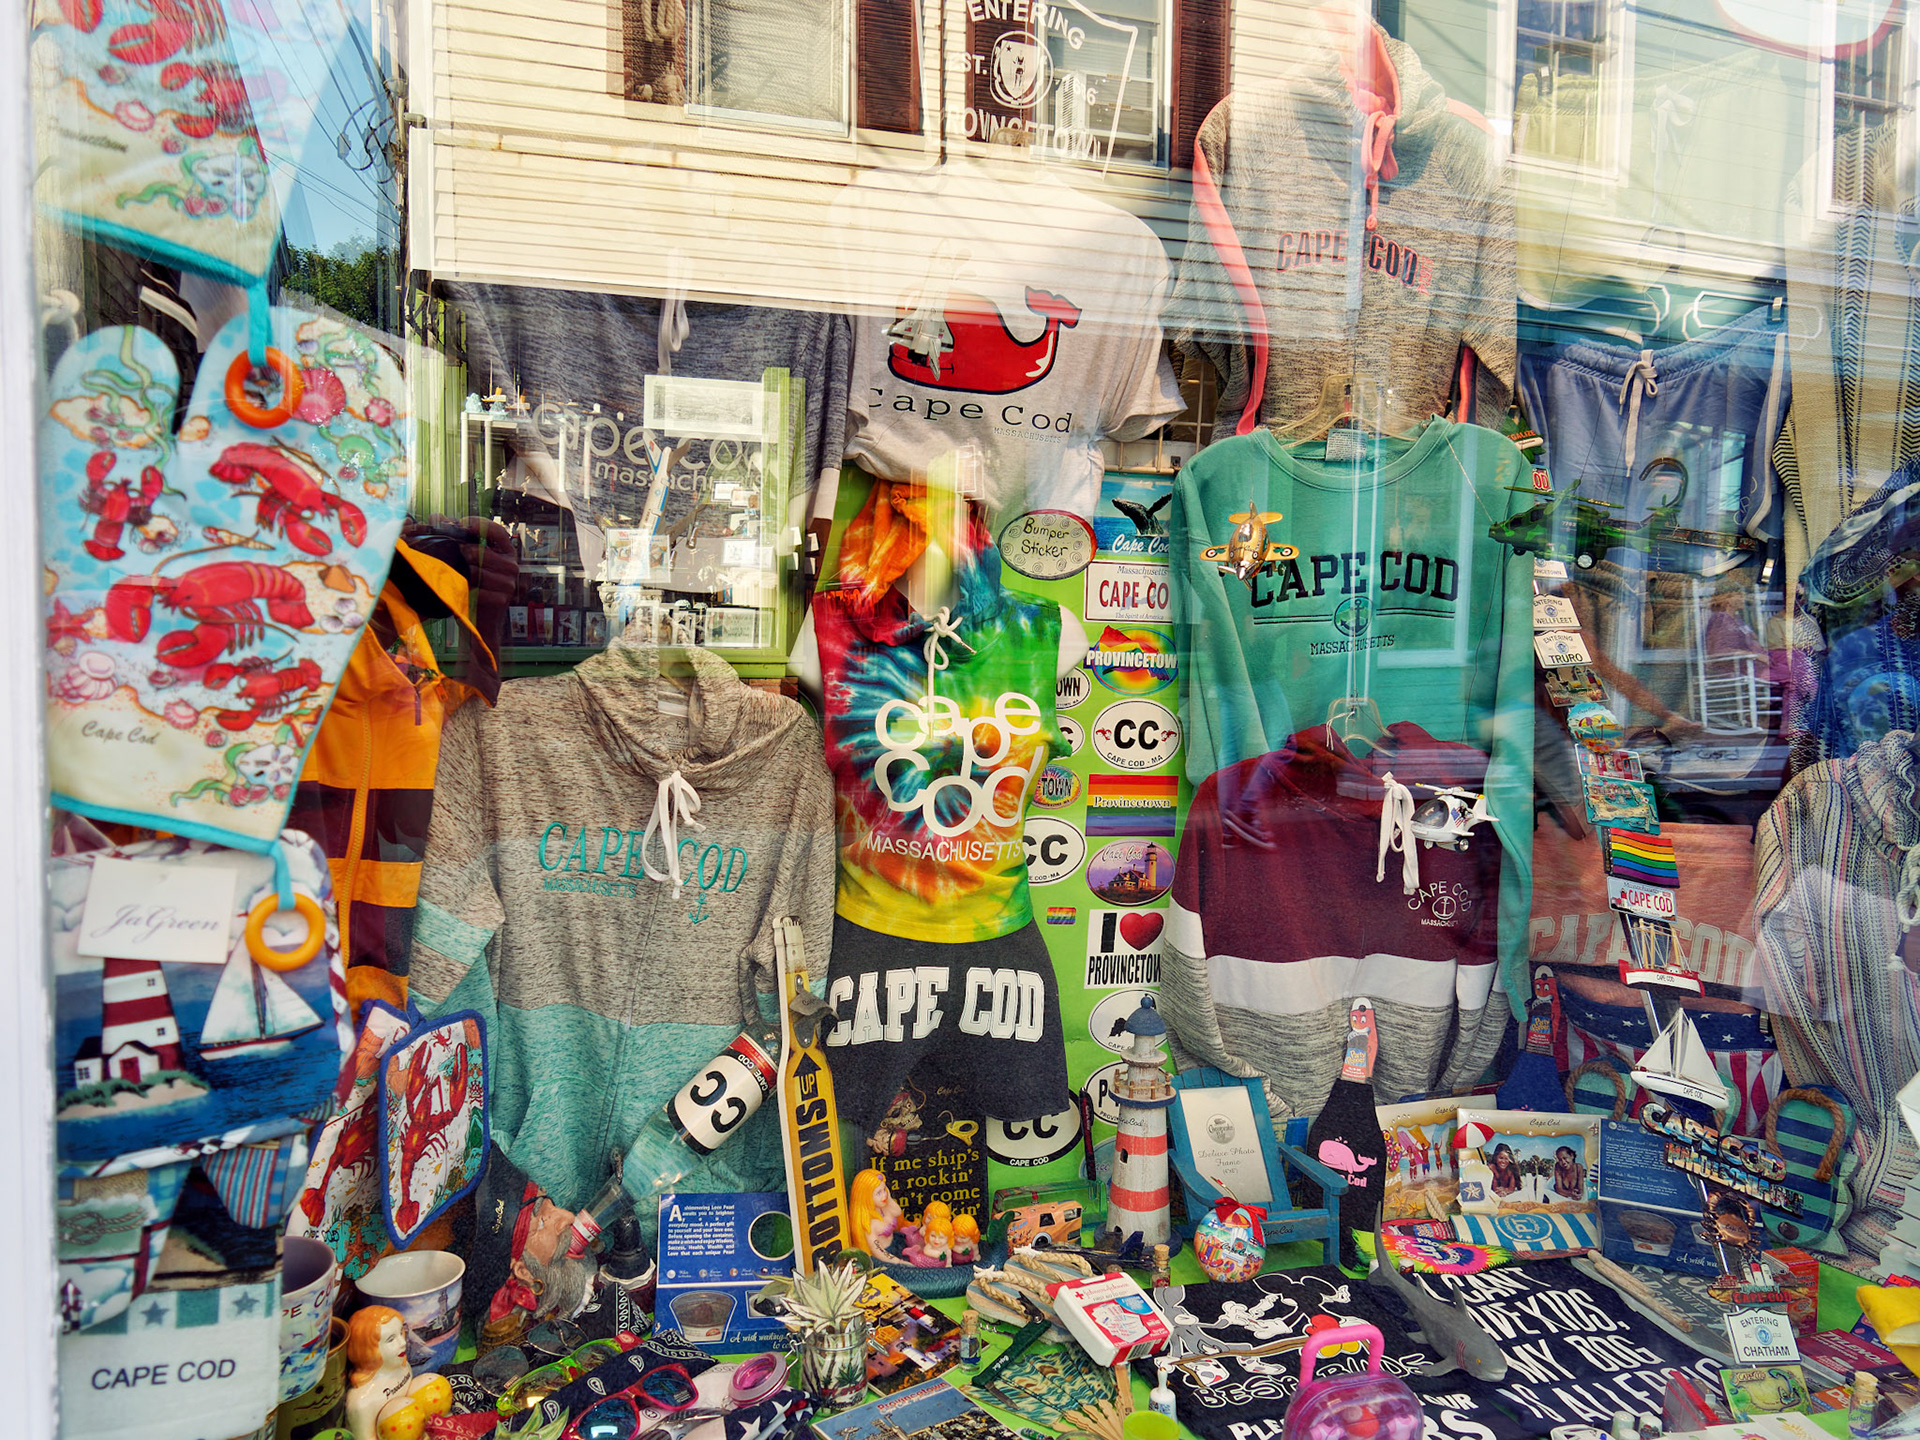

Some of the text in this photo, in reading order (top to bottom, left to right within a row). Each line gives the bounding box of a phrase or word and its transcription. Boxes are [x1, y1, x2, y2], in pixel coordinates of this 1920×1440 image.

[967, 0, 1086, 50] ENTERING
[1276, 229, 1419, 288] CAPE COD
[1001, 405, 1073, 433] Cod
[1532, 472, 1550, 490] OD
[1023, 517, 1070, 542] Bumper
[1021, 539, 1069, 558] Sticker
[1112, 534, 1144, 554] Cape
[1117, 565, 1169, 575] Massachusetts
[1251, 551, 1459, 608] CAPE COD
[1100, 580, 1171, 610] CAPE CO
[1536, 616, 1573, 624] WELLFLEET
[1310, 634, 1395, 655] MASSACHUSETTS
[1543, 634, 1574, 644] ENTERING
[1087, 650, 1178, 669] PROVINCETOW
[1549, 653, 1584, 664] TRURO
[82, 720, 160, 745] Cape Cod
[1113, 718, 1160, 750] CC
[1106, 751, 1164, 767] CAPE COD MA
[874, 745, 1045, 837] cod
[1093, 796, 1172, 808] Provincetown
[539, 822, 748, 893] CAPE COD
[866, 831, 1022, 862] MASSACHUSETTS
[1127, 844, 1143, 862] Cod
[544, 877, 637, 898] MASSACHUSETTS
[1407, 880, 1472, 912] CAPE COD
[1628, 889, 1652, 908] CAPE
[1653, 895, 1673, 913] COD
[1100, 912, 1118, 953] I
[1529, 912, 1632, 965] CAPE
[1087, 953, 1161, 986] PROVINCETOW
[826, 966, 1045, 1047] CAPE COD
[737, 1053, 755, 1069] COD
[753, 1068, 768, 1091] CAPE
[690, 1070, 747, 1134] CC
[1434, 1106, 1449, 1115] Cape
[1529, 1118, 1560, 1127] Cape Cod
[870, 1149, 980, 1173] If me ship's
[1009, 1156, 1049, 1167] CAPE COD
[1198, 1147, 1256, 1159] Deluxe Photo
[796, 1074, 843, 1272] BOTTOMS UP
[891, 1168, 973, 1191] a rockin'
[1347, 1173, 1368, 1187] Cod
[931, 1187, 980, 1203] come
[669, 1205, 682, 1221] A
[1689, 1256, 1706, 1265] wish
[1733, 1291, 1792, 1304] CAPE COD
[1514, 1288, 1632, 1334] KIDS,
[1740, 1316, 1779, 1328] ENTERING
[742, 1331, 758, 1342] wish
[772, 1342, 780, 1350] to
[1499, 1334, 1666, 1384] MY DOG
[1743, 1345, 1791, 1357] CHATHAM
[91, 1358, 237, 1390] CAPE COD
[877, 1381, 949, 1410] Provincetown
[1495, 1383, 1567, 1423] IS
